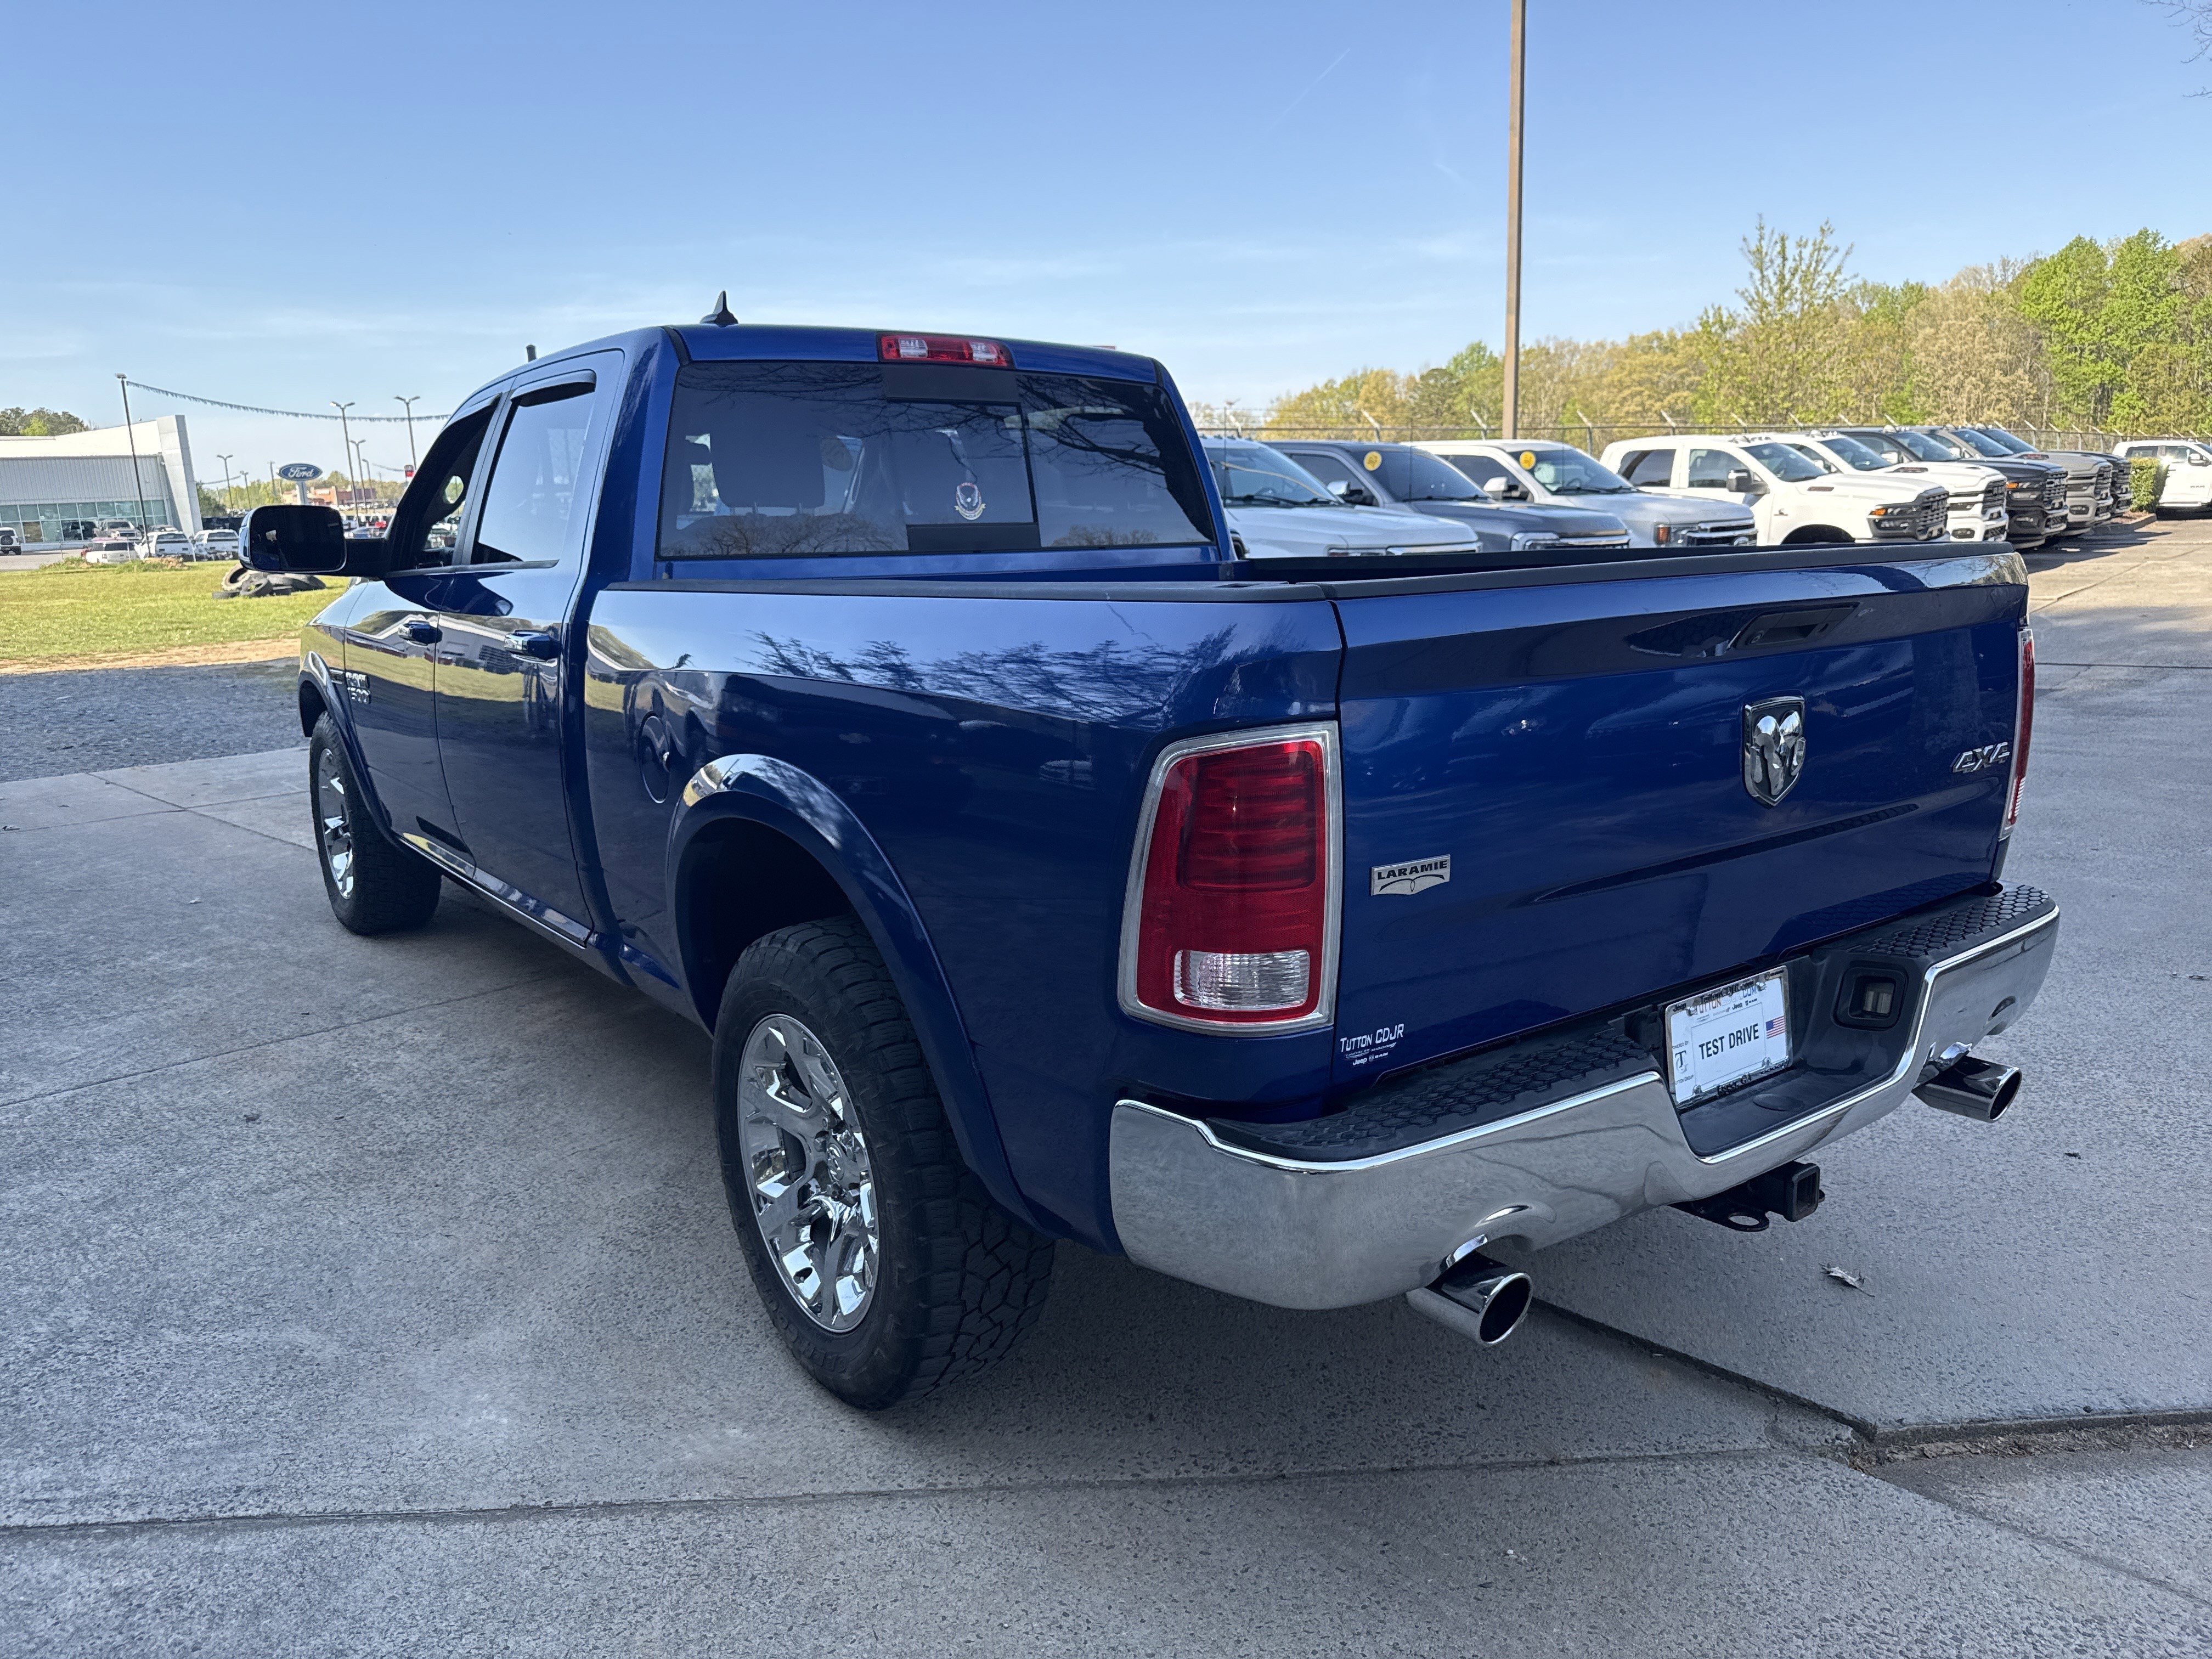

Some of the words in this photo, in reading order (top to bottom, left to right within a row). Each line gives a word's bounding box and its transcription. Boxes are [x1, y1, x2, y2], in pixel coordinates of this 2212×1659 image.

[288, 467, 314, 478] Ford
[1378, 860, 1447, 880] LARAMIE
[1673, 1003, 1686, 1012] Jeep
[1375, 1023, 1404, 1043] CDJR
[1699, 1036, 1725, 1059] TEST
[1729, 1023, 1759, 1049] DRIVE
[1353, 1057, 1367, 1065] Jeep
